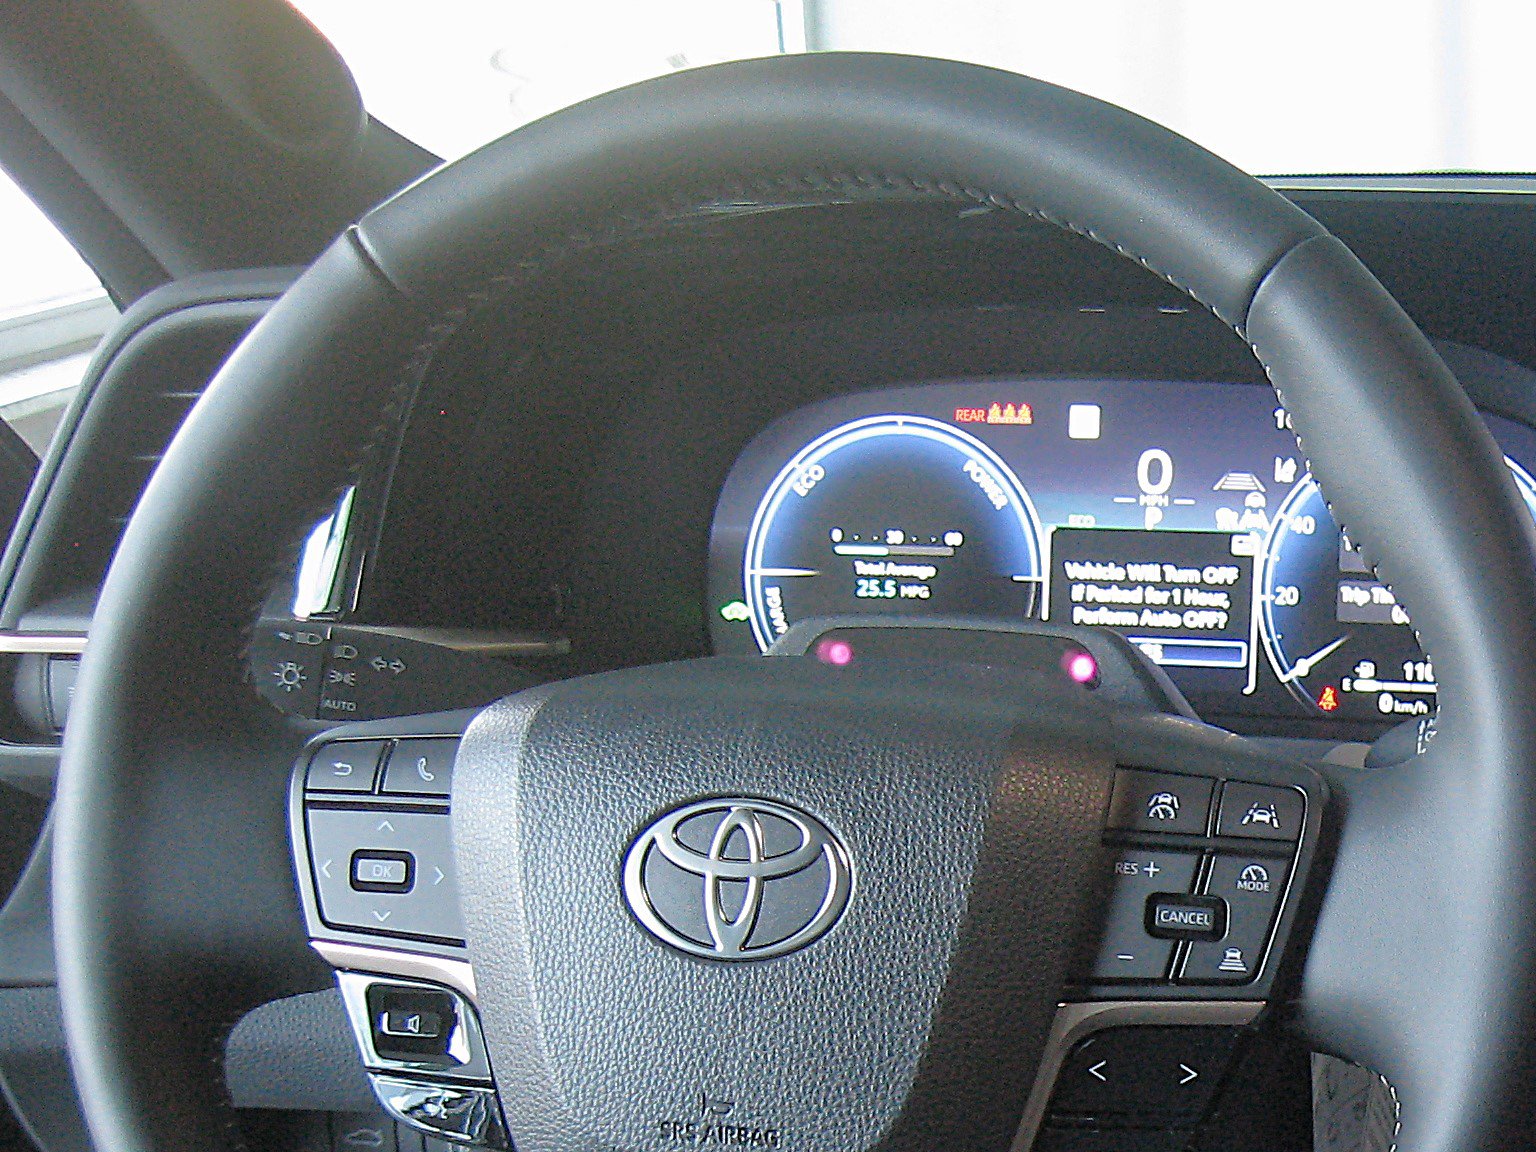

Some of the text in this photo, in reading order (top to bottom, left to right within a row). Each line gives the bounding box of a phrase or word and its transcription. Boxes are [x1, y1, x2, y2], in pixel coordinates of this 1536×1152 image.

[954, 408, 986, 423] REAR
[793, 464, 826, 497] ECO
[1136, 449, 1174, 495] 0
[962, 459, 1008, 511] POWER
[1139, 495, 1169, 507] MPH
[1144, 506, 1163, 530] P
[829, 527, 843, 543] 0
[853, 558, 938, 581] Total Average
[1064, 560, 1240, 585] Vehicle Will Turn OFF
[855, 577, 931, 599] 25.5 MPG
[1070, 582, 1086, 603] If
[1086, 584, 1143, 605] Parked
[1144, 585, 1171, 605] for
[1171, 588, 1182, 605] 1
[1274, 585, 1300, 606] 20
[1340, 585, 1371, 606] Trip
[1072, 605, 1229, 629] Perform Auto OFF?
[1341, 677, 1352, 692] E
[322, 699, 357, 713] AUTO
[1378, 692, 1429, 716] 0 km/h
[372, 864, 393, 878] OK
[1115, 862, 1139, 876] RES
[1236, 879, 1270, 892] MODE
[1159, 909, 1211, 927] CANCEL
[660, 1120, 782, 1149] SRS AIRBAG
